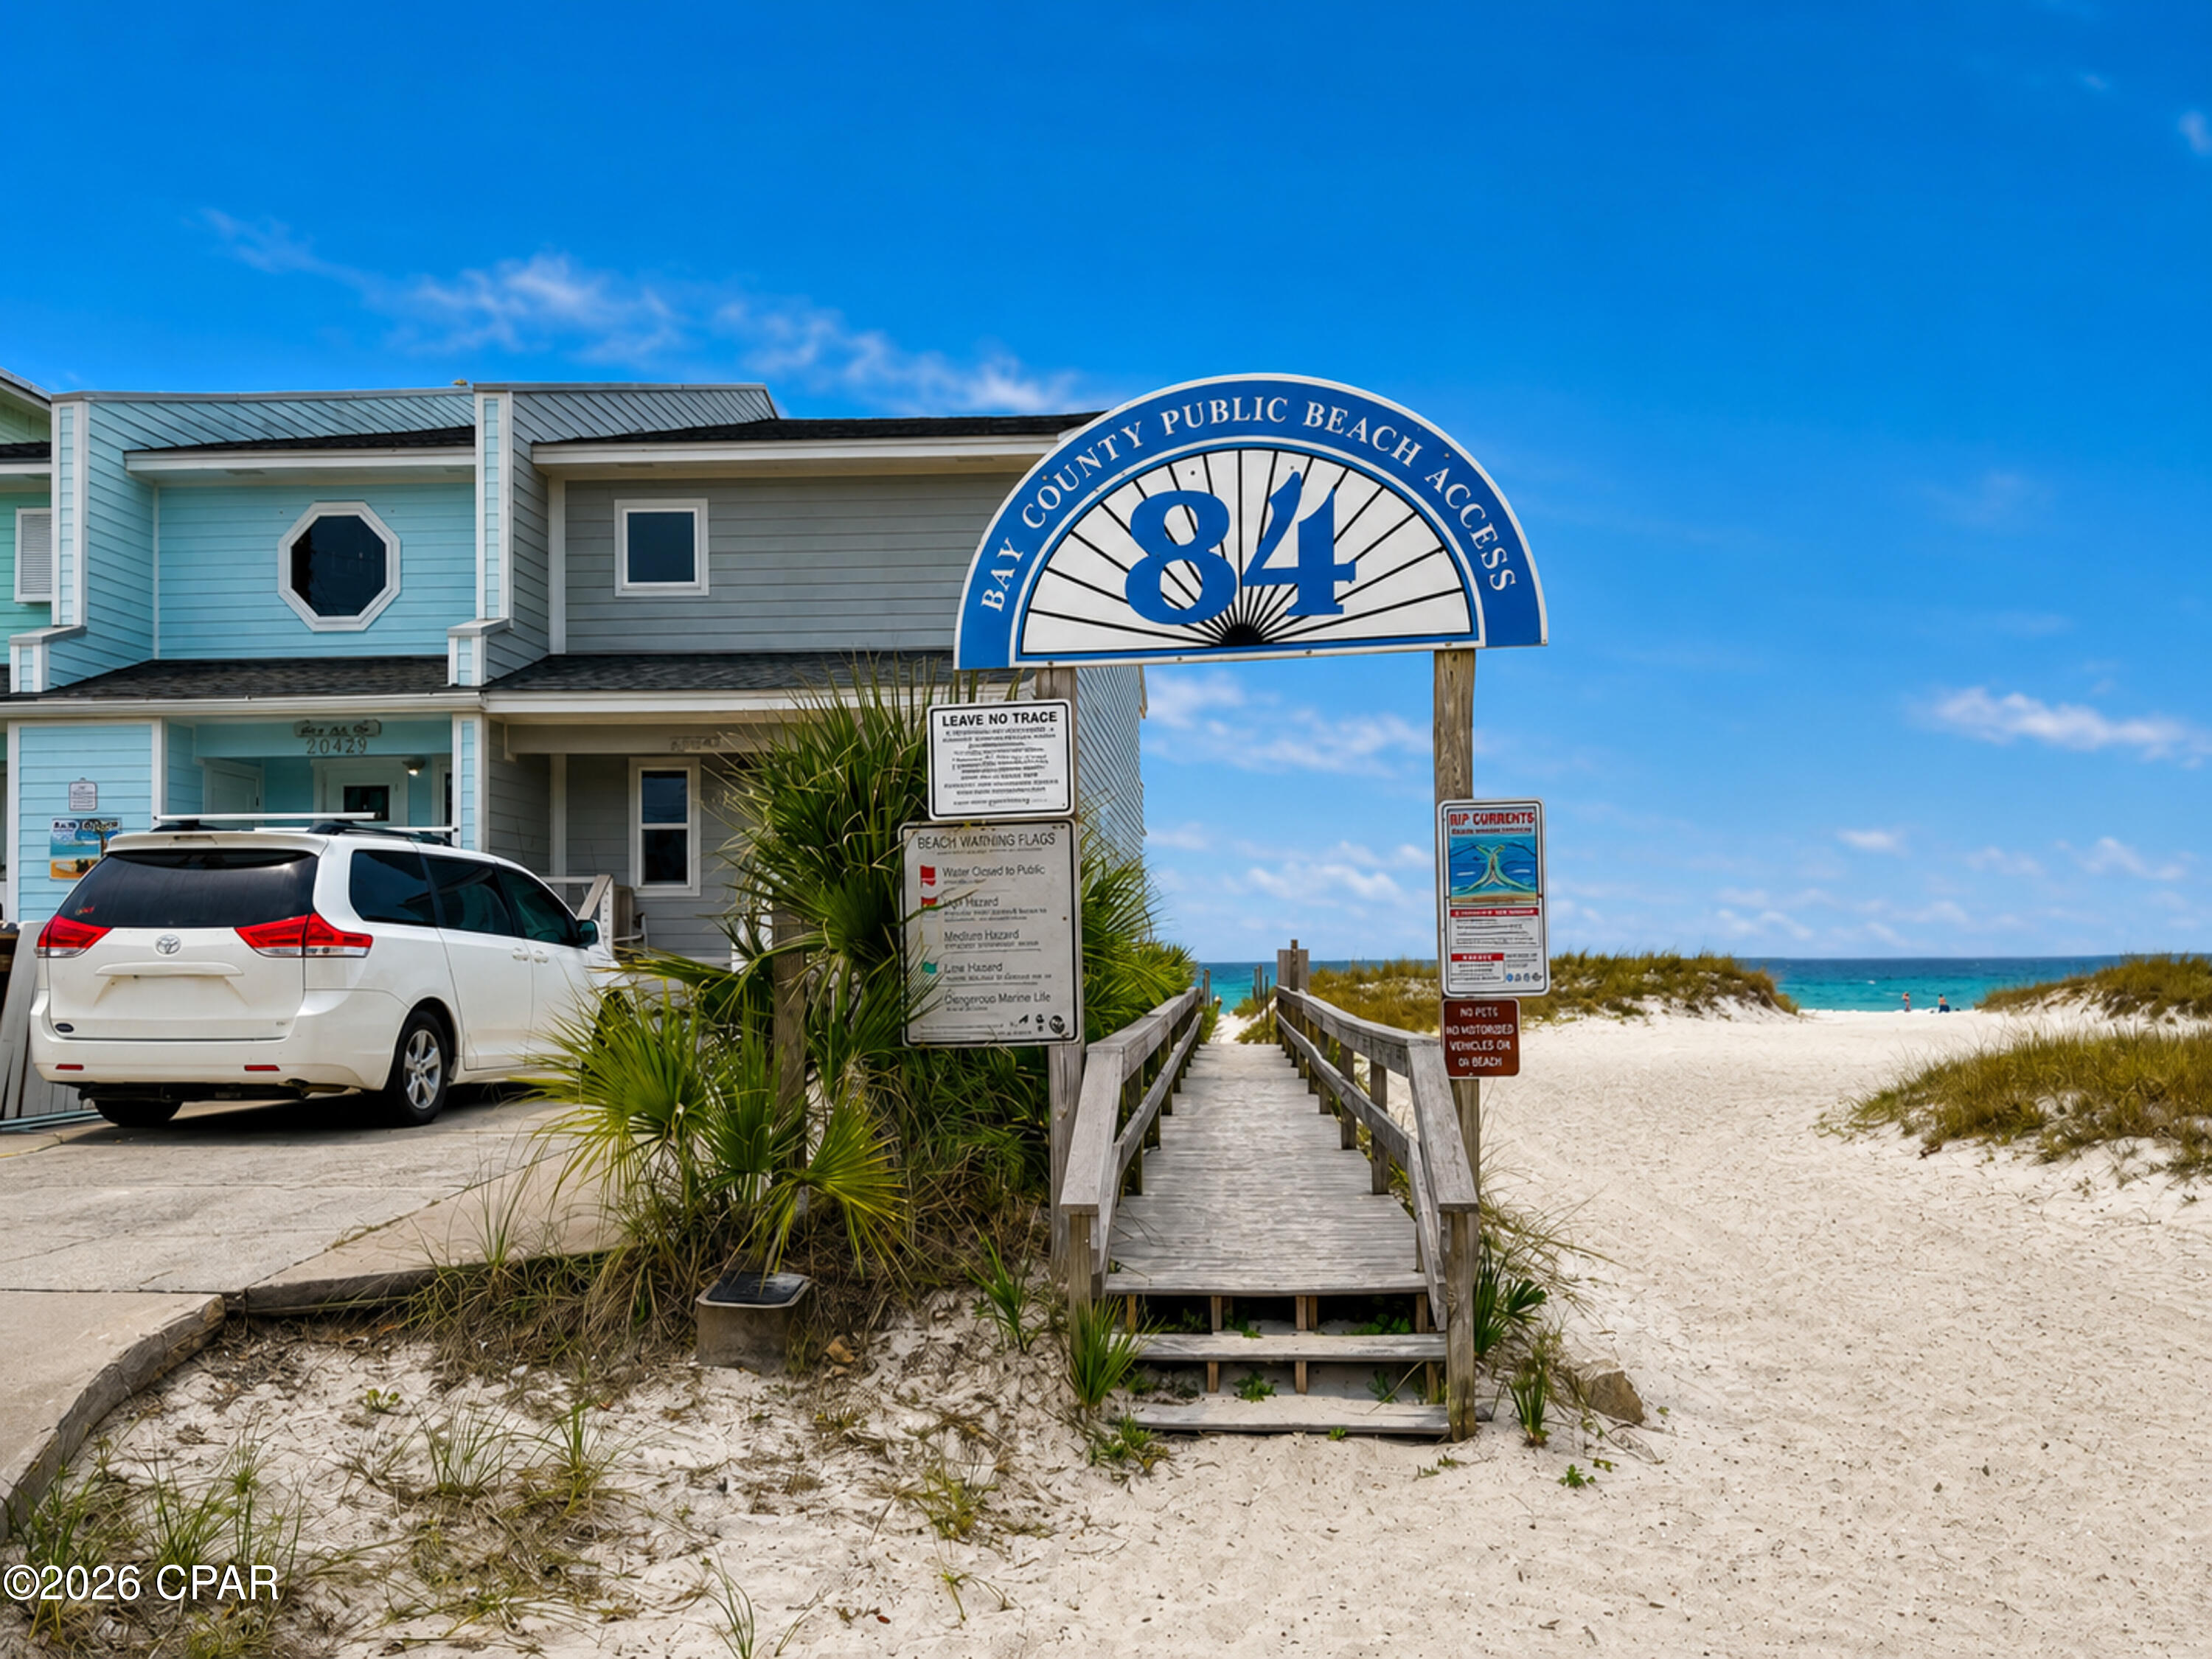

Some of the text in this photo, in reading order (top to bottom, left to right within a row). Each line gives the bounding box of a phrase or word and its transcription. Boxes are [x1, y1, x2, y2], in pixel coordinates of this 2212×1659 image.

[981, 397, 1516, 612] BAY COUNTY PUBLIC BEACH ACCESS
[1125, 472, 1357, 625] 84
[942, 712, 1057, 726] LEAVE NO TRACE
[307, 737, 367, 754] 20429
[1450, 812, 1535, 825] RIP CURRENTS
[917, 836, 956, 849] BEACH
[1018, 832, 1056, 846] FLAGS
[966, 897, 998, 908] Hazard
[984, 929, 1020, 940] Hazard
[1460, 1006, 1498, 1018] NO PETS
[1446, 1026, 1459, 1035] NO
[1472, 1056, 1503, 1068] BEACH
